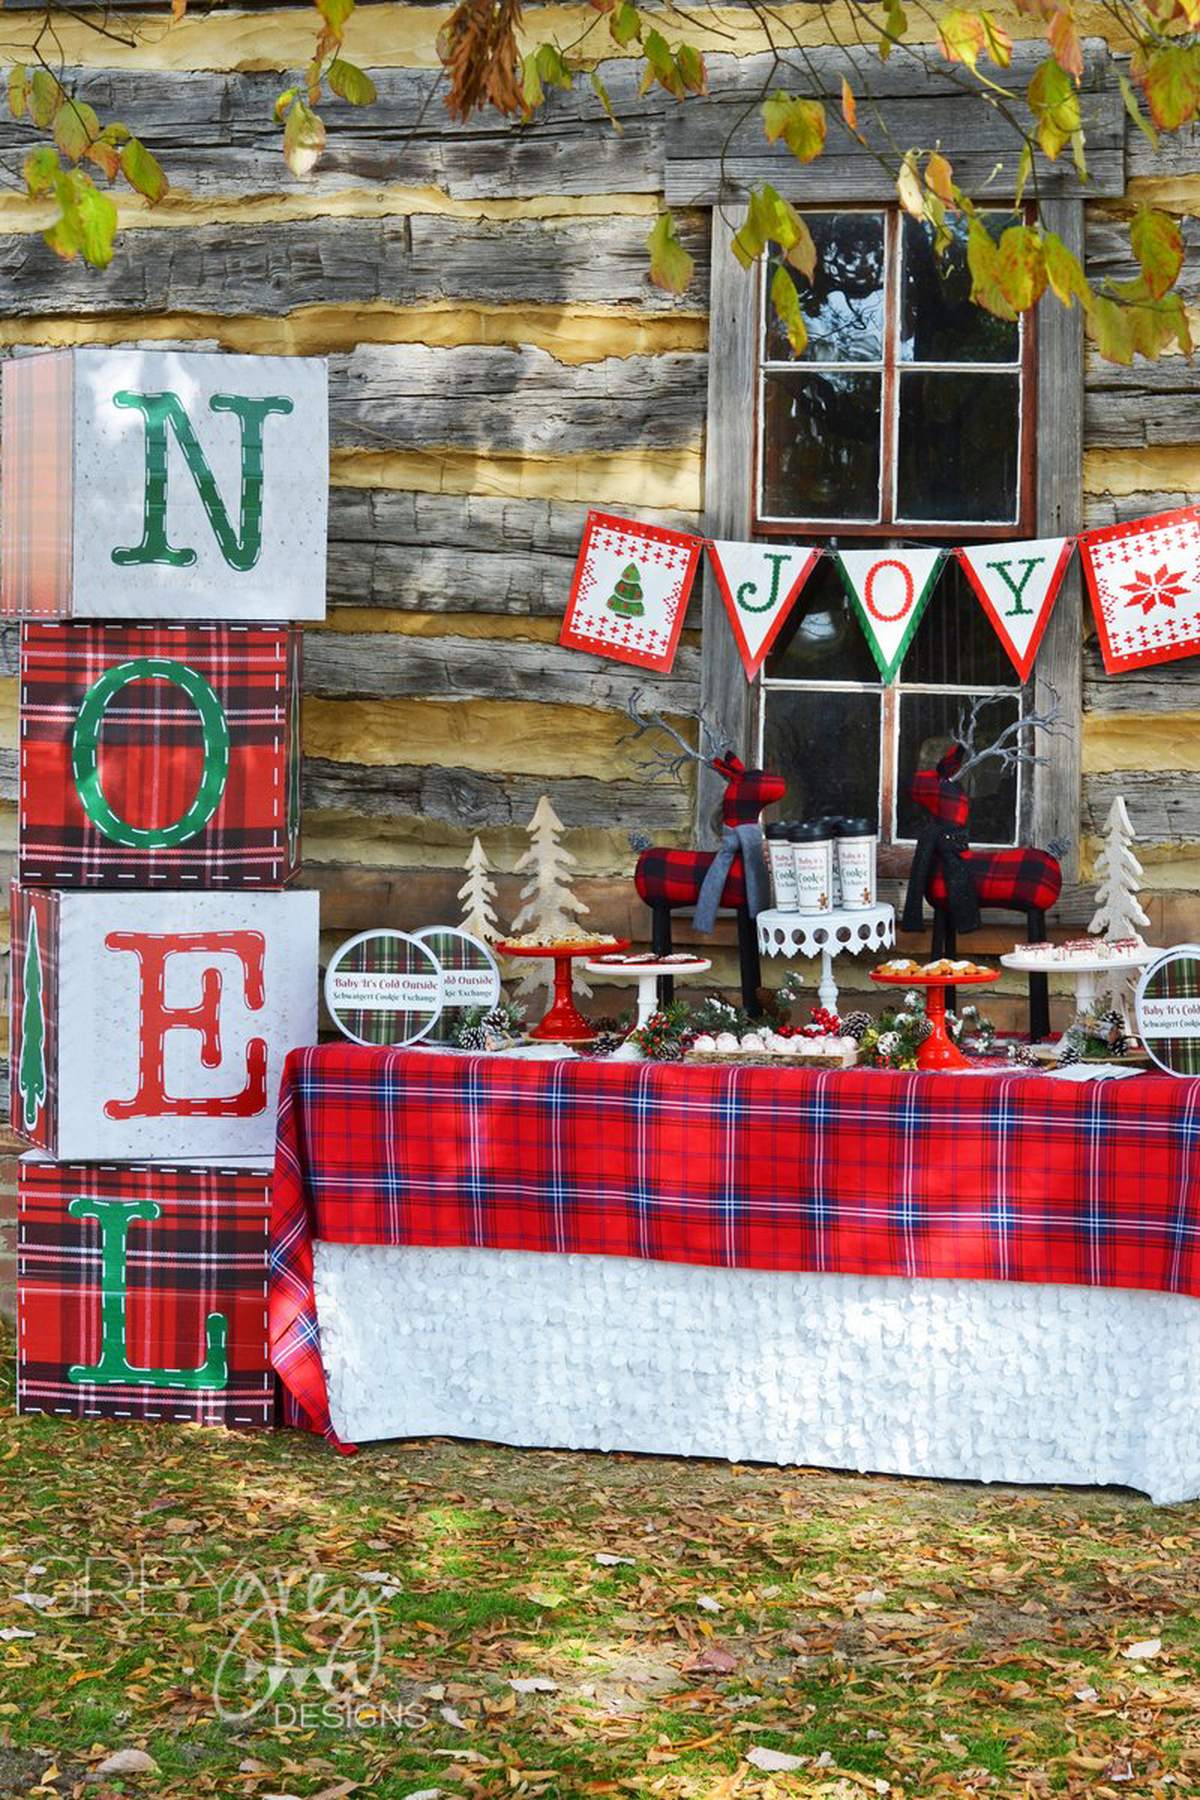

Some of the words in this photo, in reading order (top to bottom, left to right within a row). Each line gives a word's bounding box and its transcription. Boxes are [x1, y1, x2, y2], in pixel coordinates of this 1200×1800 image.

[736, 552, 1046, 623] JOY
[334, 978, 359, 989] Baby
[379, 979, 400, 990] Cold
[402, 980, 438, 991] Outside
[458, 976, 493, 985] Outside
[375, 992, 399, 1002] Cookie
[401, 994, 437, 1004] Exchange
[1142, 1004, 1164, 1017] Baby
